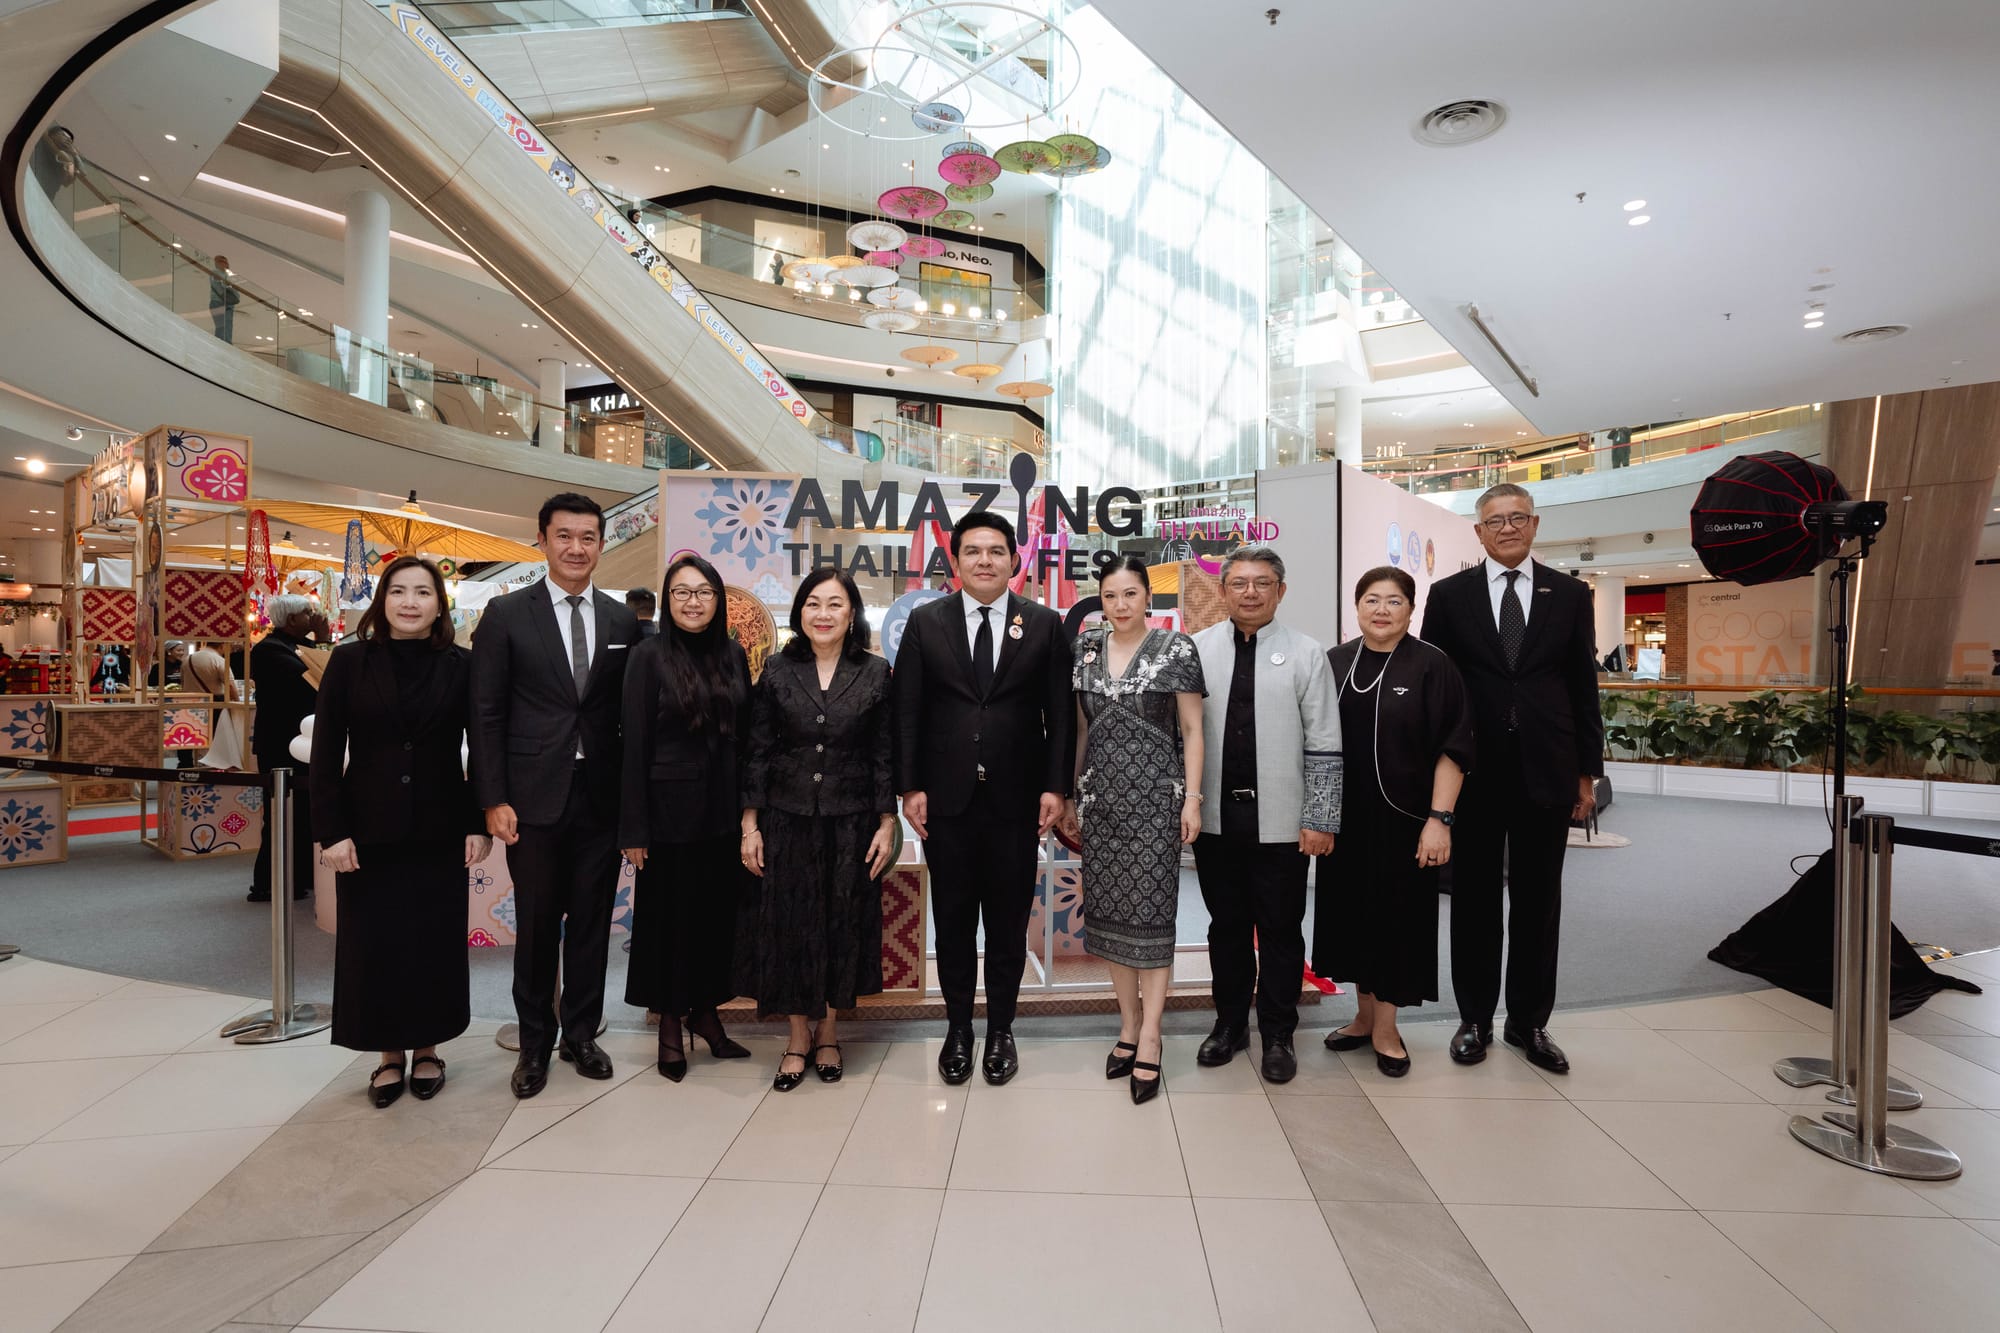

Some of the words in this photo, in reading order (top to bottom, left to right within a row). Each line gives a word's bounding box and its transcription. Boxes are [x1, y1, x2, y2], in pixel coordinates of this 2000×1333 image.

[414, 27, 460, 75] LEVEL
[463, 75, 474, 87] 2
[504, 112, 545, 153] TOY
[961, 251, 992, 266] Neo.
[706, 315, 734, 347] LEVEL
[736, 345, 743, 354] 2
[763, 369, 789, 398] TOY
[783, 453, 1144, 546] AMAZING
[1190, 505, 1246, 520] amazing
[1157, 520, 1280, 541] THAILAND
[1714, 522, 1734, 532] Quick
[1734, 523, 1751, 531] Para
[1752, 521, 1764, 529] 70
[783, 543, 1021, 579] THAILA
[1710, 593, 1740, 602] central
[1695, 610, 1813, 641] GOOD
[1695, 645, 1811, 686] STA
